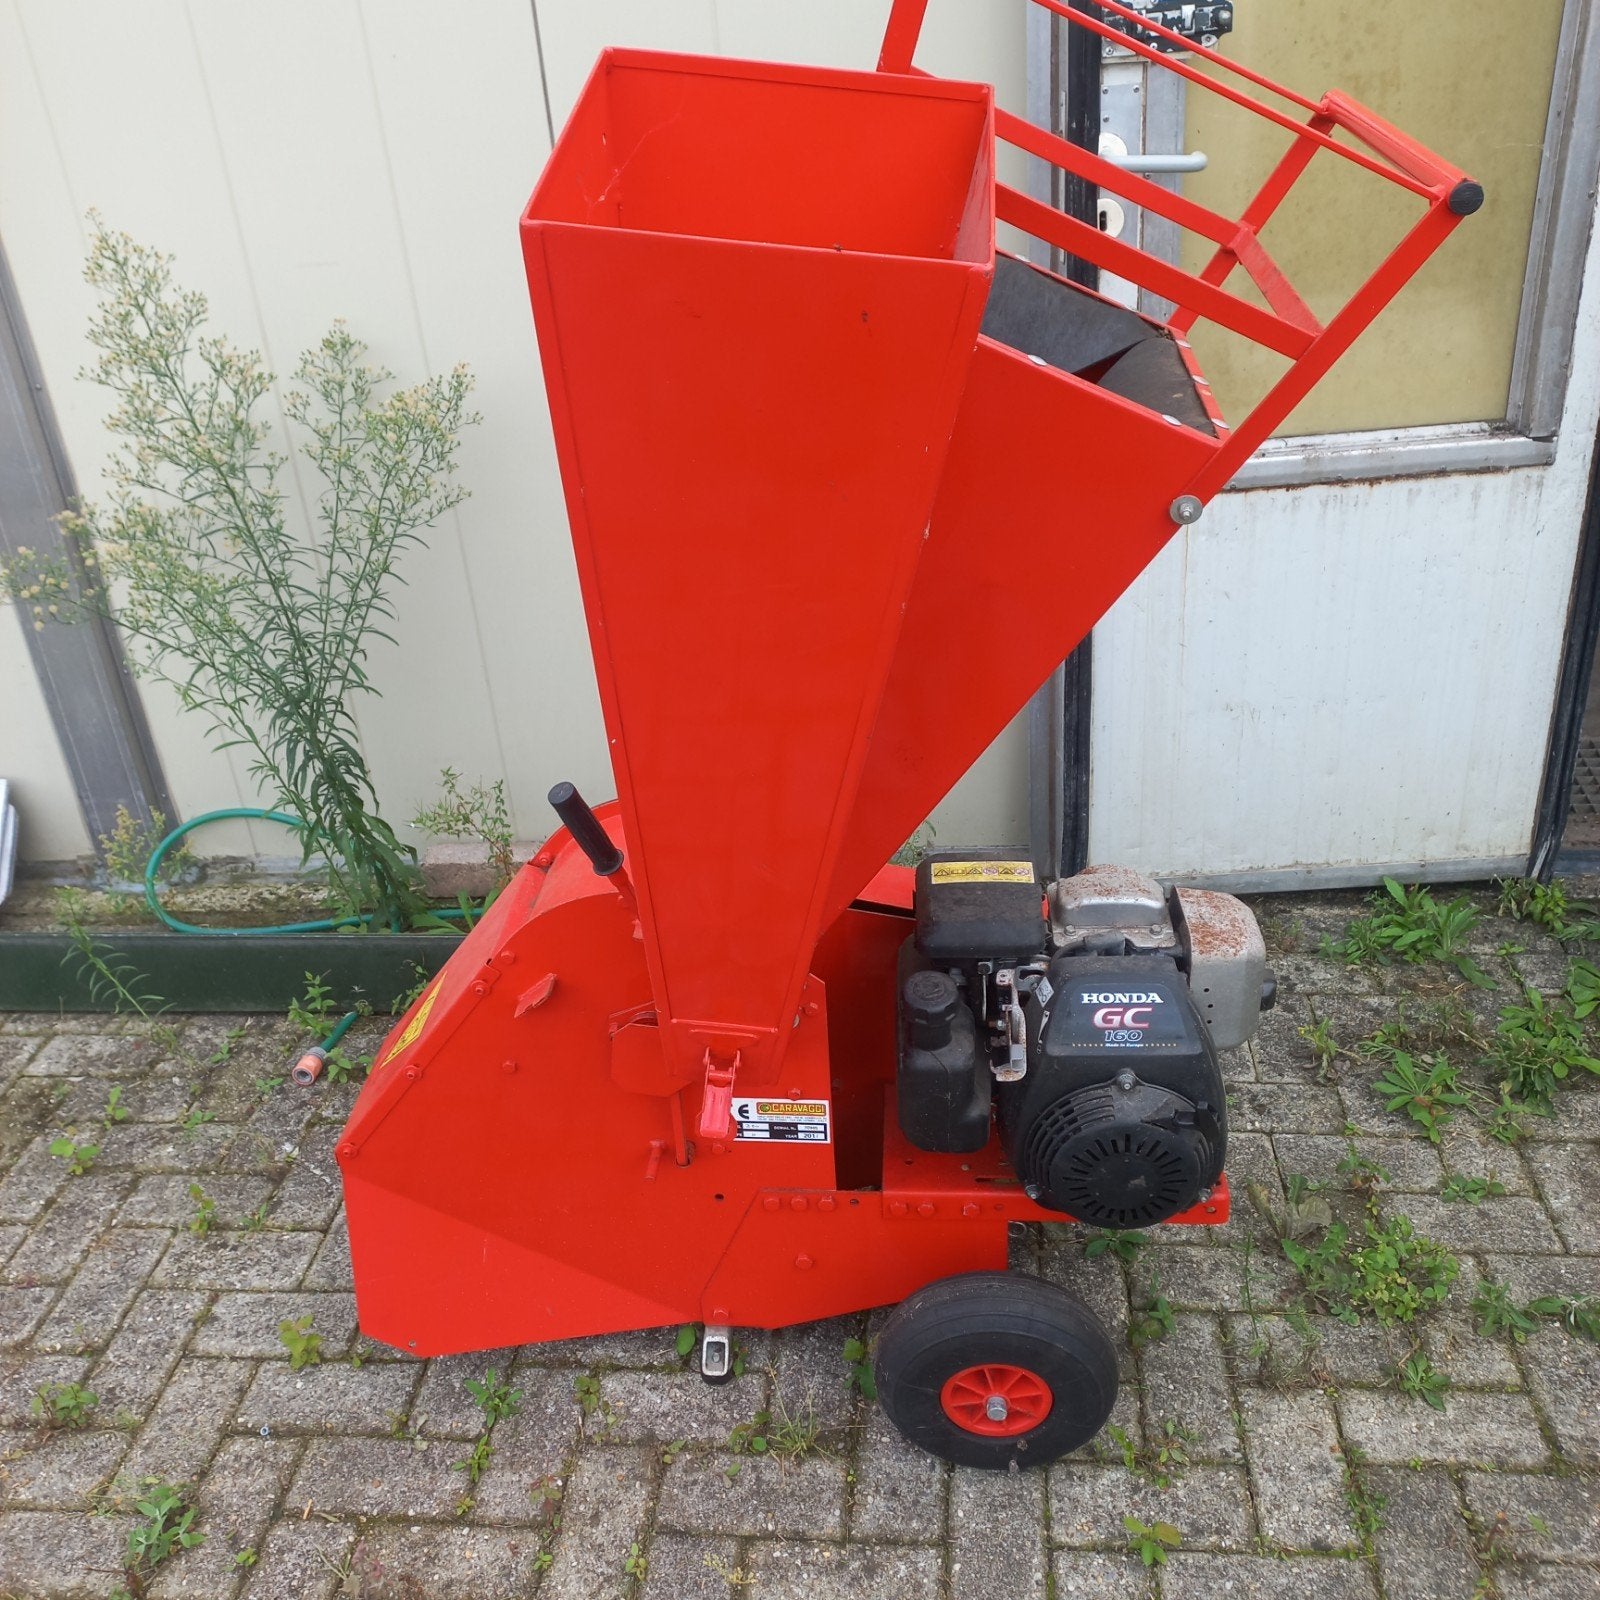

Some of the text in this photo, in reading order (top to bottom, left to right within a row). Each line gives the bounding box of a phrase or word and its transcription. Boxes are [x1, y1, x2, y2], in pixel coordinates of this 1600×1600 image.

[1081, 992, 1164, 1004] HONDA
[1093, 1007, 1153, 1029] GC
[1104, 1029, 1143, 1042] 160
[772, 1103, 824, 1113] CARAVAGGI
